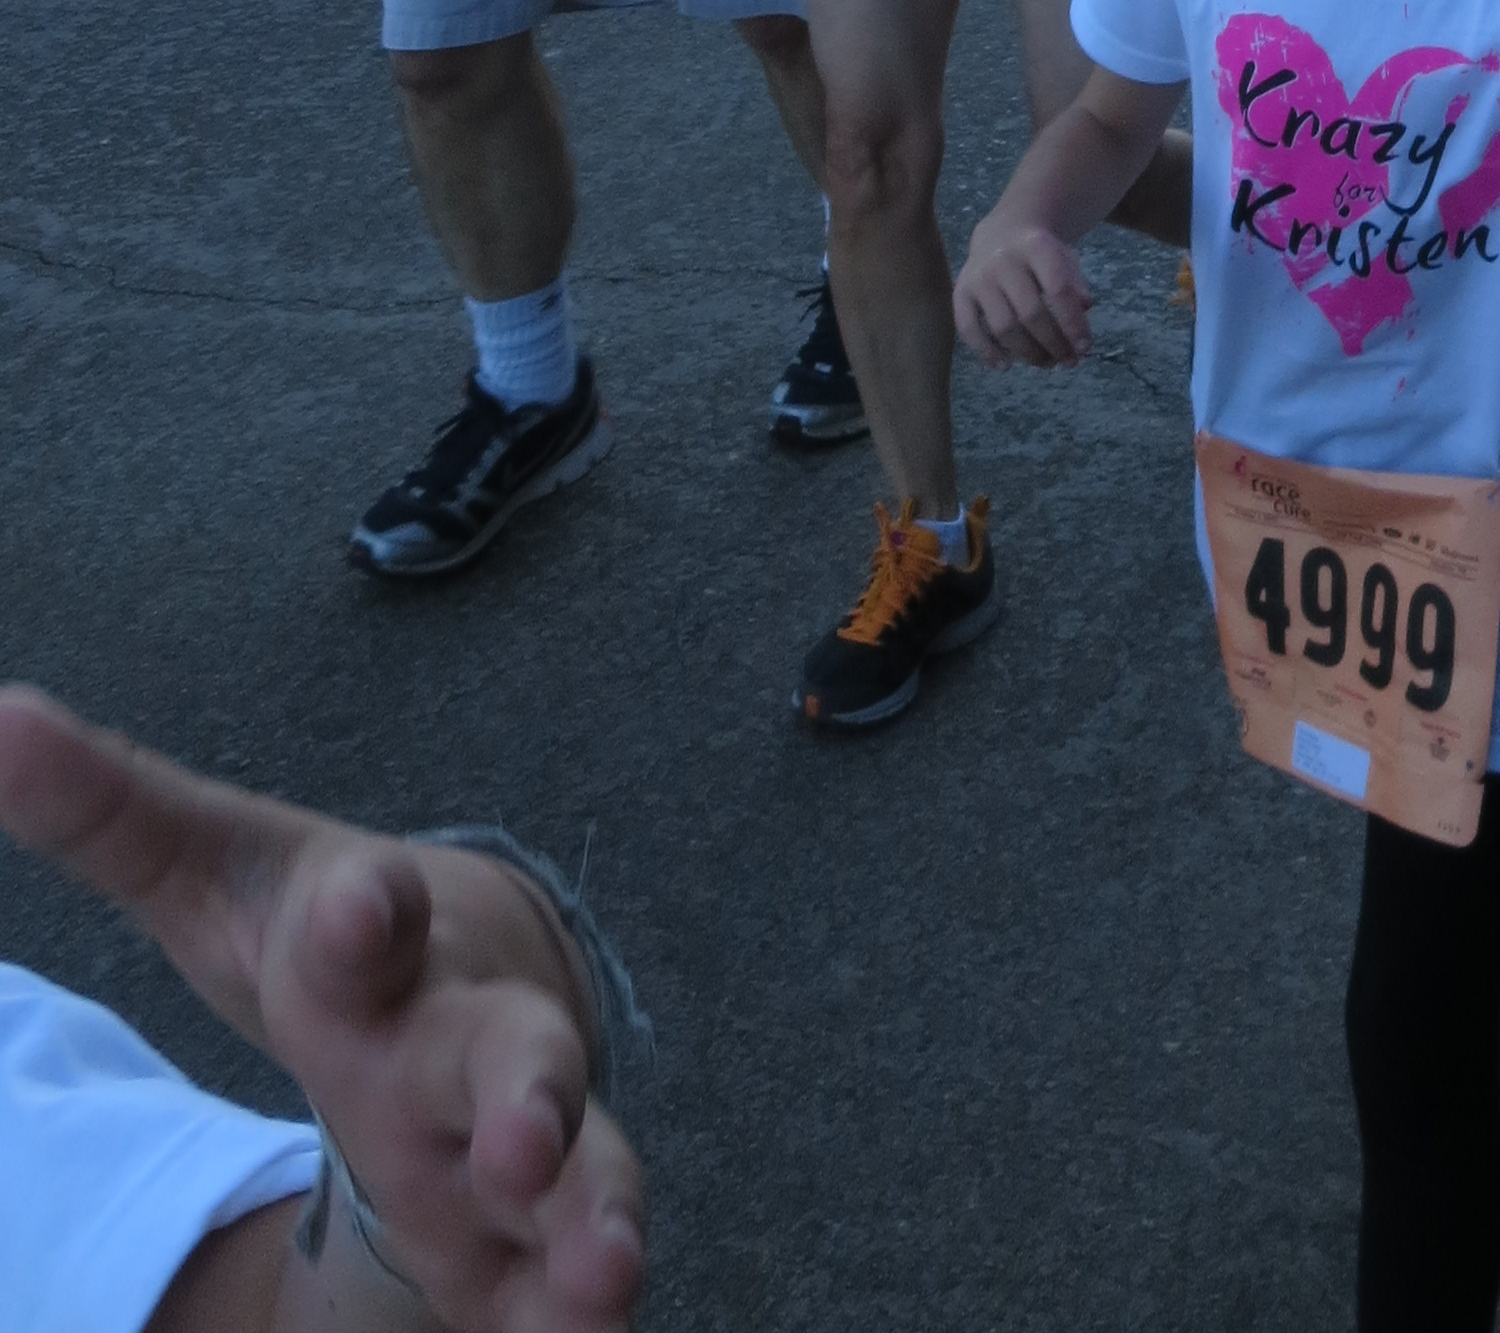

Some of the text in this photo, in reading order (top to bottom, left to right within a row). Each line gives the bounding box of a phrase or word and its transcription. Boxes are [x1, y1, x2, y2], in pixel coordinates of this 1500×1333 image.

[1238, 60, 1457, 217] Krazy
[1333, 171, 1378, 209] for
[1231, 178, 1499, 279] Kristen
[1251, 477, 1301, 502] race
[1272, 499, 1312, 521] cure
[1244, 536, 1456, 713] 4999
